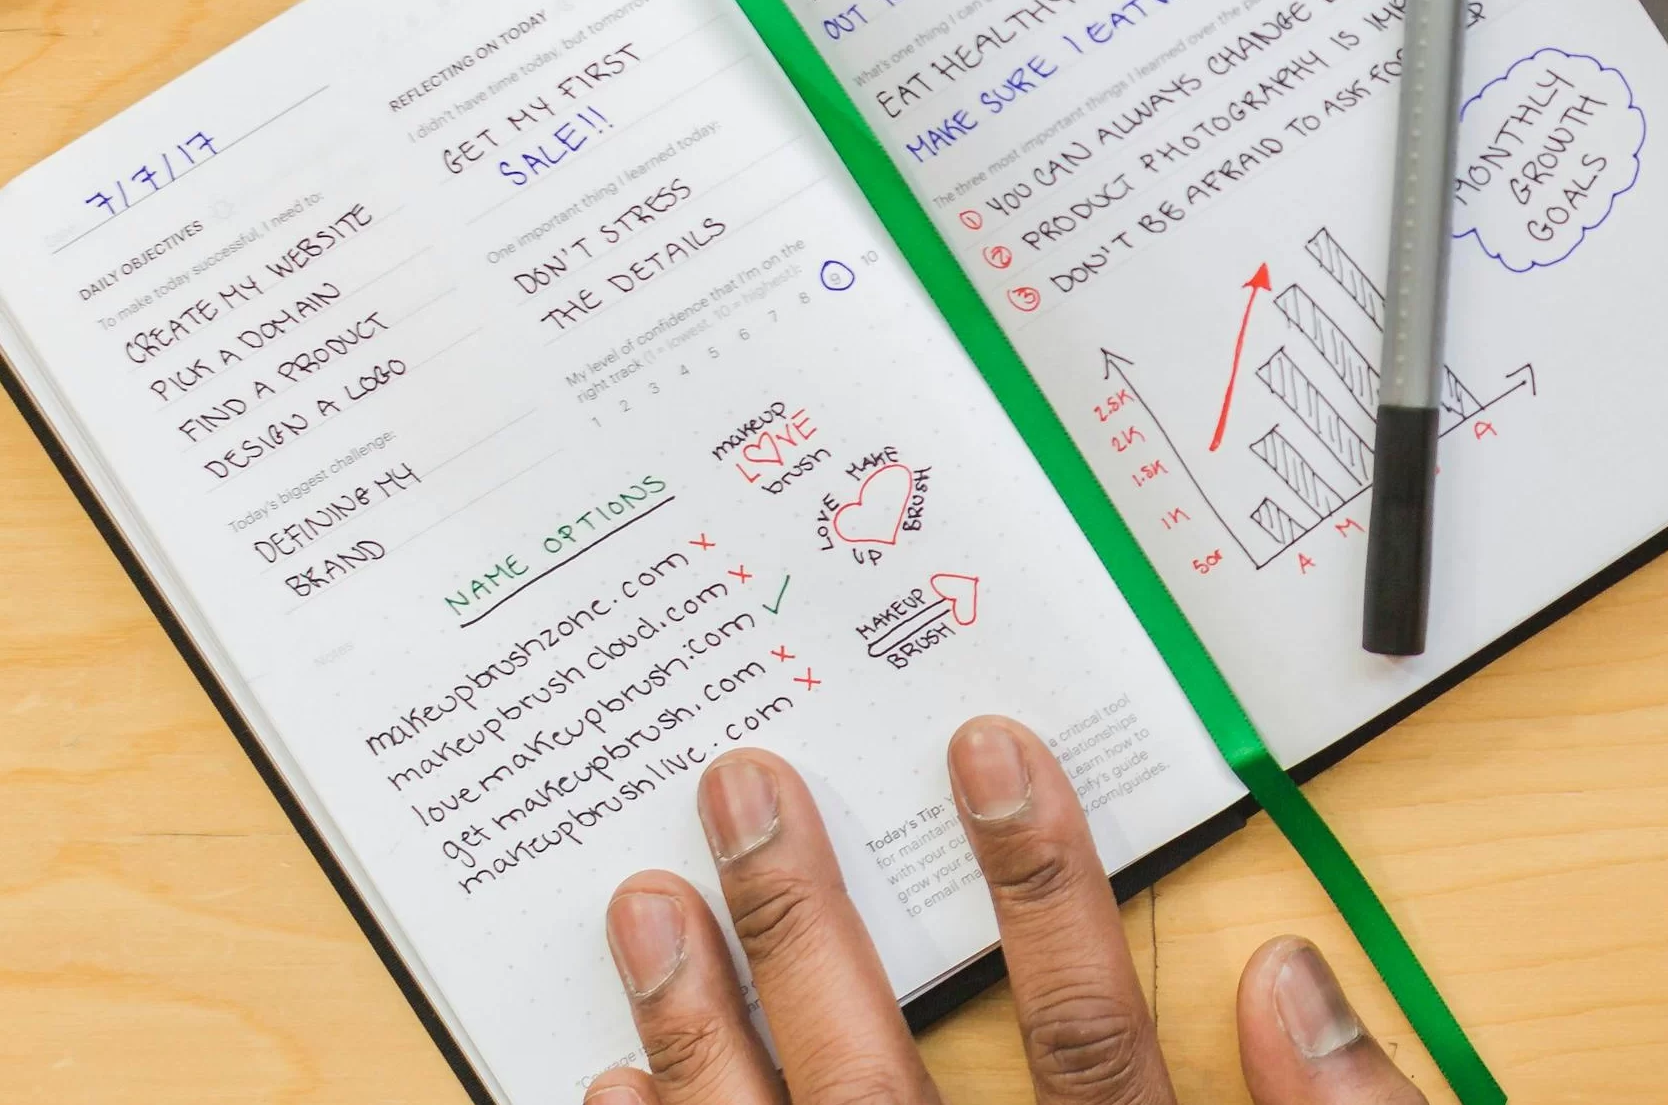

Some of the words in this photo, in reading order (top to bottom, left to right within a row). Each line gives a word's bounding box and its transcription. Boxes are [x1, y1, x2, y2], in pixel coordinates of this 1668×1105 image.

[389, 55, 474, 112] REFLECTING
[476, 42, 500, 60] ON
[499, 12, 546, 45] TODAY
[822, 4, 869, 41] OUT
[442, 128, 499, 175] GET
[506, 96, 556, 132] MY
[556, 42, 641, 100] FIRST
[498, 105, 614, 187] SALE!!
[875, 71, 933, 119] EAT
[905, 109, 979, 164] MAKE
[979, 56, 1058, 114] SURE
[1062, 35, 1084, 54] I
[985, 182, 1033, 217] YOU
[1032, 141, 1093, 187] CAN
[1097, 74, 1202, 146] ALWAYS
[1207, 1, 1313, 76] CHANGE
[1020, 172, 1135, 251] PRODUCT
[1139, 49, 1329, 173] PHOTOGRAPHY
[1329, 30, 1360, 52] IS
[1510, 94, 1608, 206] GROWTH
[84, 131, 220, 216] 7/7/17
[1048, 231, 1133, 294] DON'T
[1137, 200, 1186, 234] BE
[1186, 137, 1284, 206] AFRAID
[1284, 114, 1321, 137] TO
[1323, 78, 1372, 116] ASK
[1527, 153, 1607, 242] GOALS
[78, 273, 117, 302] DAILY
[121, 220, 203, 276] OBJECTIVES
[96, 316, 118, 331] To
[116, 294, 154, 321] make
[151, 271, 191, 299] today
[262, 221, 271, 232] I
[270, 199, 305, 228] need
[125, 299, 219, 365] CREATE
[217, 274, 265, 310] MY
[264, 203, 373, 279] WEBSITE
[512, 236, 593, 295] DON'T
[599, 177, 692, 245] STRESS
[539, 288, 603, 330] THE
[605, 217, 727, 294] DETAILS
[149, 358, 216, 402] PICK
[218, 349, 244, 366] A
[236, 281, 342, 349] DOMAIN
[563, 369, 588, 388] My
[585, 348, 621, 375] level
[620, 338, 636, 356] of
[635, 297, 710, 346] confidence
[708, 279, 740, 302] that
[761, 254, 781, 271] on
[779, 239, 805, 259] the
[590, 416, 603, 428] 1
[618, 398, 632, 414] 2
[647, 381, 661, 395] 3
[679, 363, 691, 376] 4
[707, 346, 721, 360] 5
[737, 327, 751, 342] 6
[766, 309, 778, 323] 7
[798, 291, 811, 305] 8
[859, 249, 879, 267] 10
[177, 398, 248, 443] FIND
[253, 381, 277, 400] A
[277, 311, 390, 383] PRODUCT
[203, 413, 309, 480] DESIGN
[316, 399, 342, 417] A
[343, 358, 407, 401] LOGO
[576, 378, 611, 404] right
[608, 358, 645, 384] track
[252, 486, 371, 564] DEFINING
[373, 462, 423, 499] MY
[276, 468, 330, 505] biggest
[284, 539, 386, 598] BRAND
[444, 554, 530, 616] NAME
[542, 474, 667, 554] OPTIONS
[915, 803, 946, 823] Tip:
[1111, 750, 1149, 779] guide
